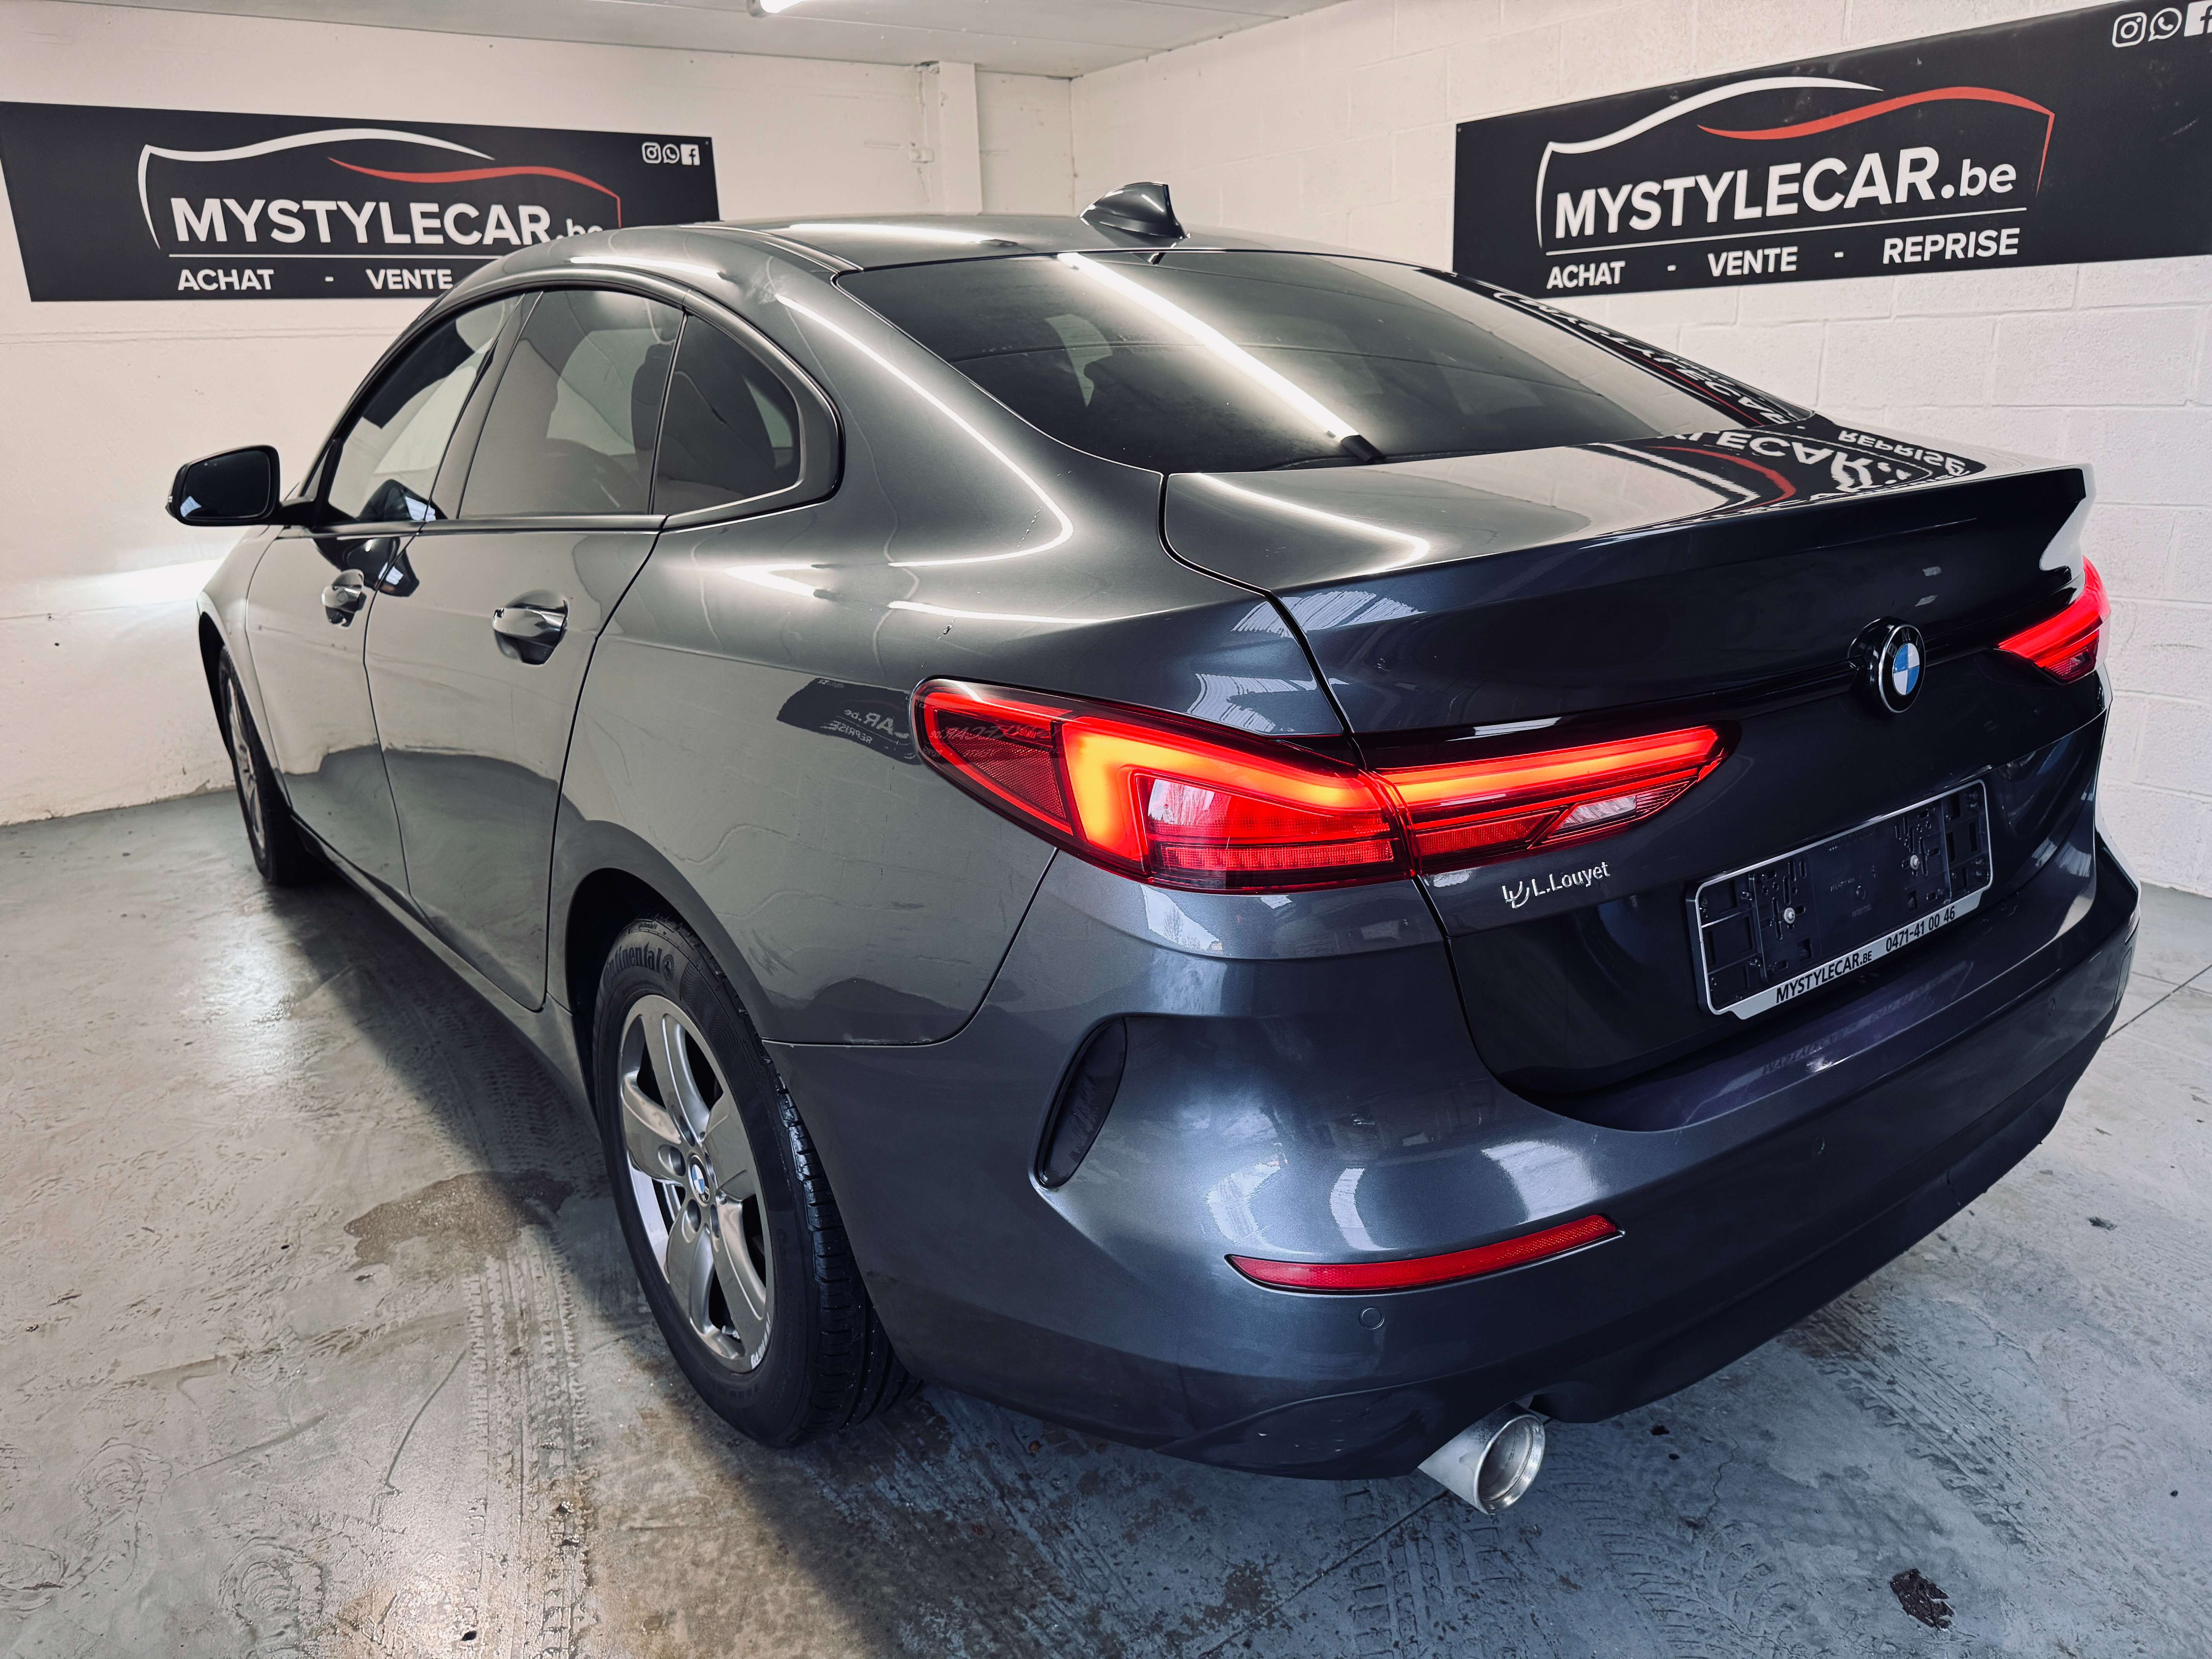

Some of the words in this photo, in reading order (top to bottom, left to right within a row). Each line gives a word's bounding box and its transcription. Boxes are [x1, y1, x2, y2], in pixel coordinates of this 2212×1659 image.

[1555, 146, 2016, 239] MYSTYLECAR.be
[177, 269, 275, 291] ACHAT
[365, 268, 453, 290] VENTE
[1546, 260, 1626, 289] ACHAT
[1707, 246, 1798, 277] VENTE
[1882, 227, 2020, 264] REPRISE
[1776, 950, 1872, 1004] MYSTYLECAR.BE
[1886, 921, 1925, 952] 0471-41
[1928, 914, 1940, 931] 00
[1944, 905, 1955, 922] 46
